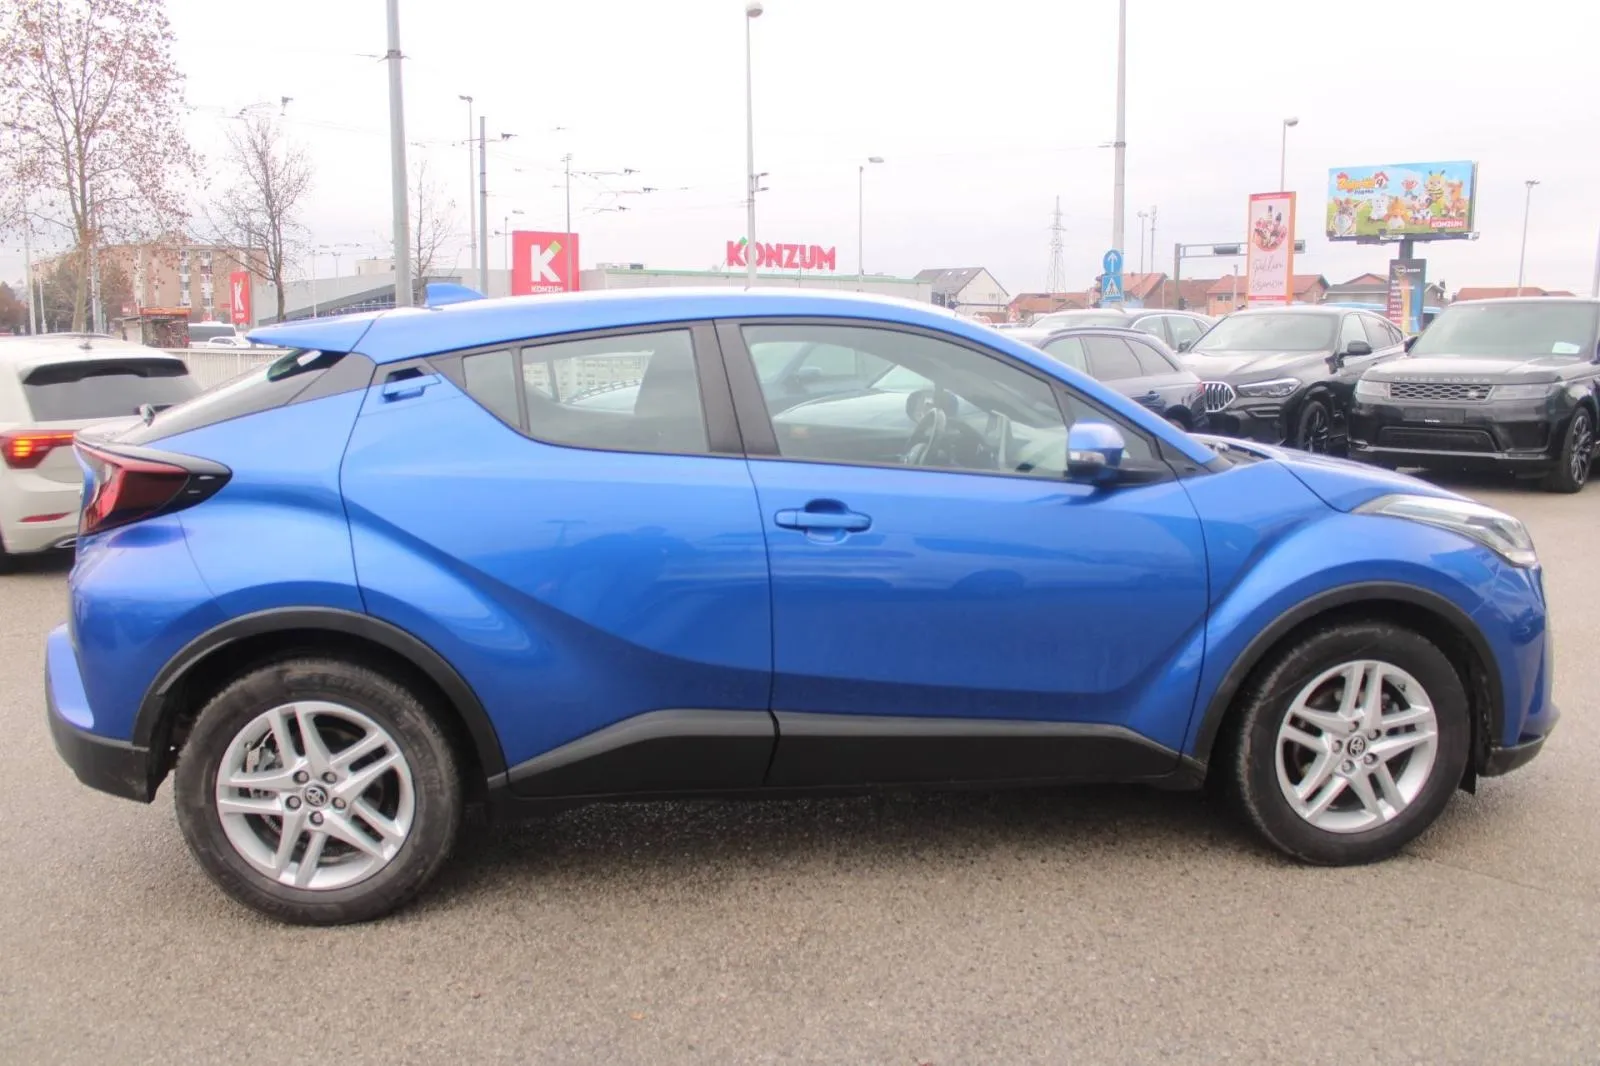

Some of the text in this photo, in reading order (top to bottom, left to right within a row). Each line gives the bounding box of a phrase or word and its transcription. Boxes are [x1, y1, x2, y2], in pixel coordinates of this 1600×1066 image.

[1375, 178, 1384, 188] 4
[531, 240, 562, 282] K
[727, 237, 836, 270] KONZUM
[234, 278, 245, 311] K
[1443, 376, 1491, 384] ROVER
